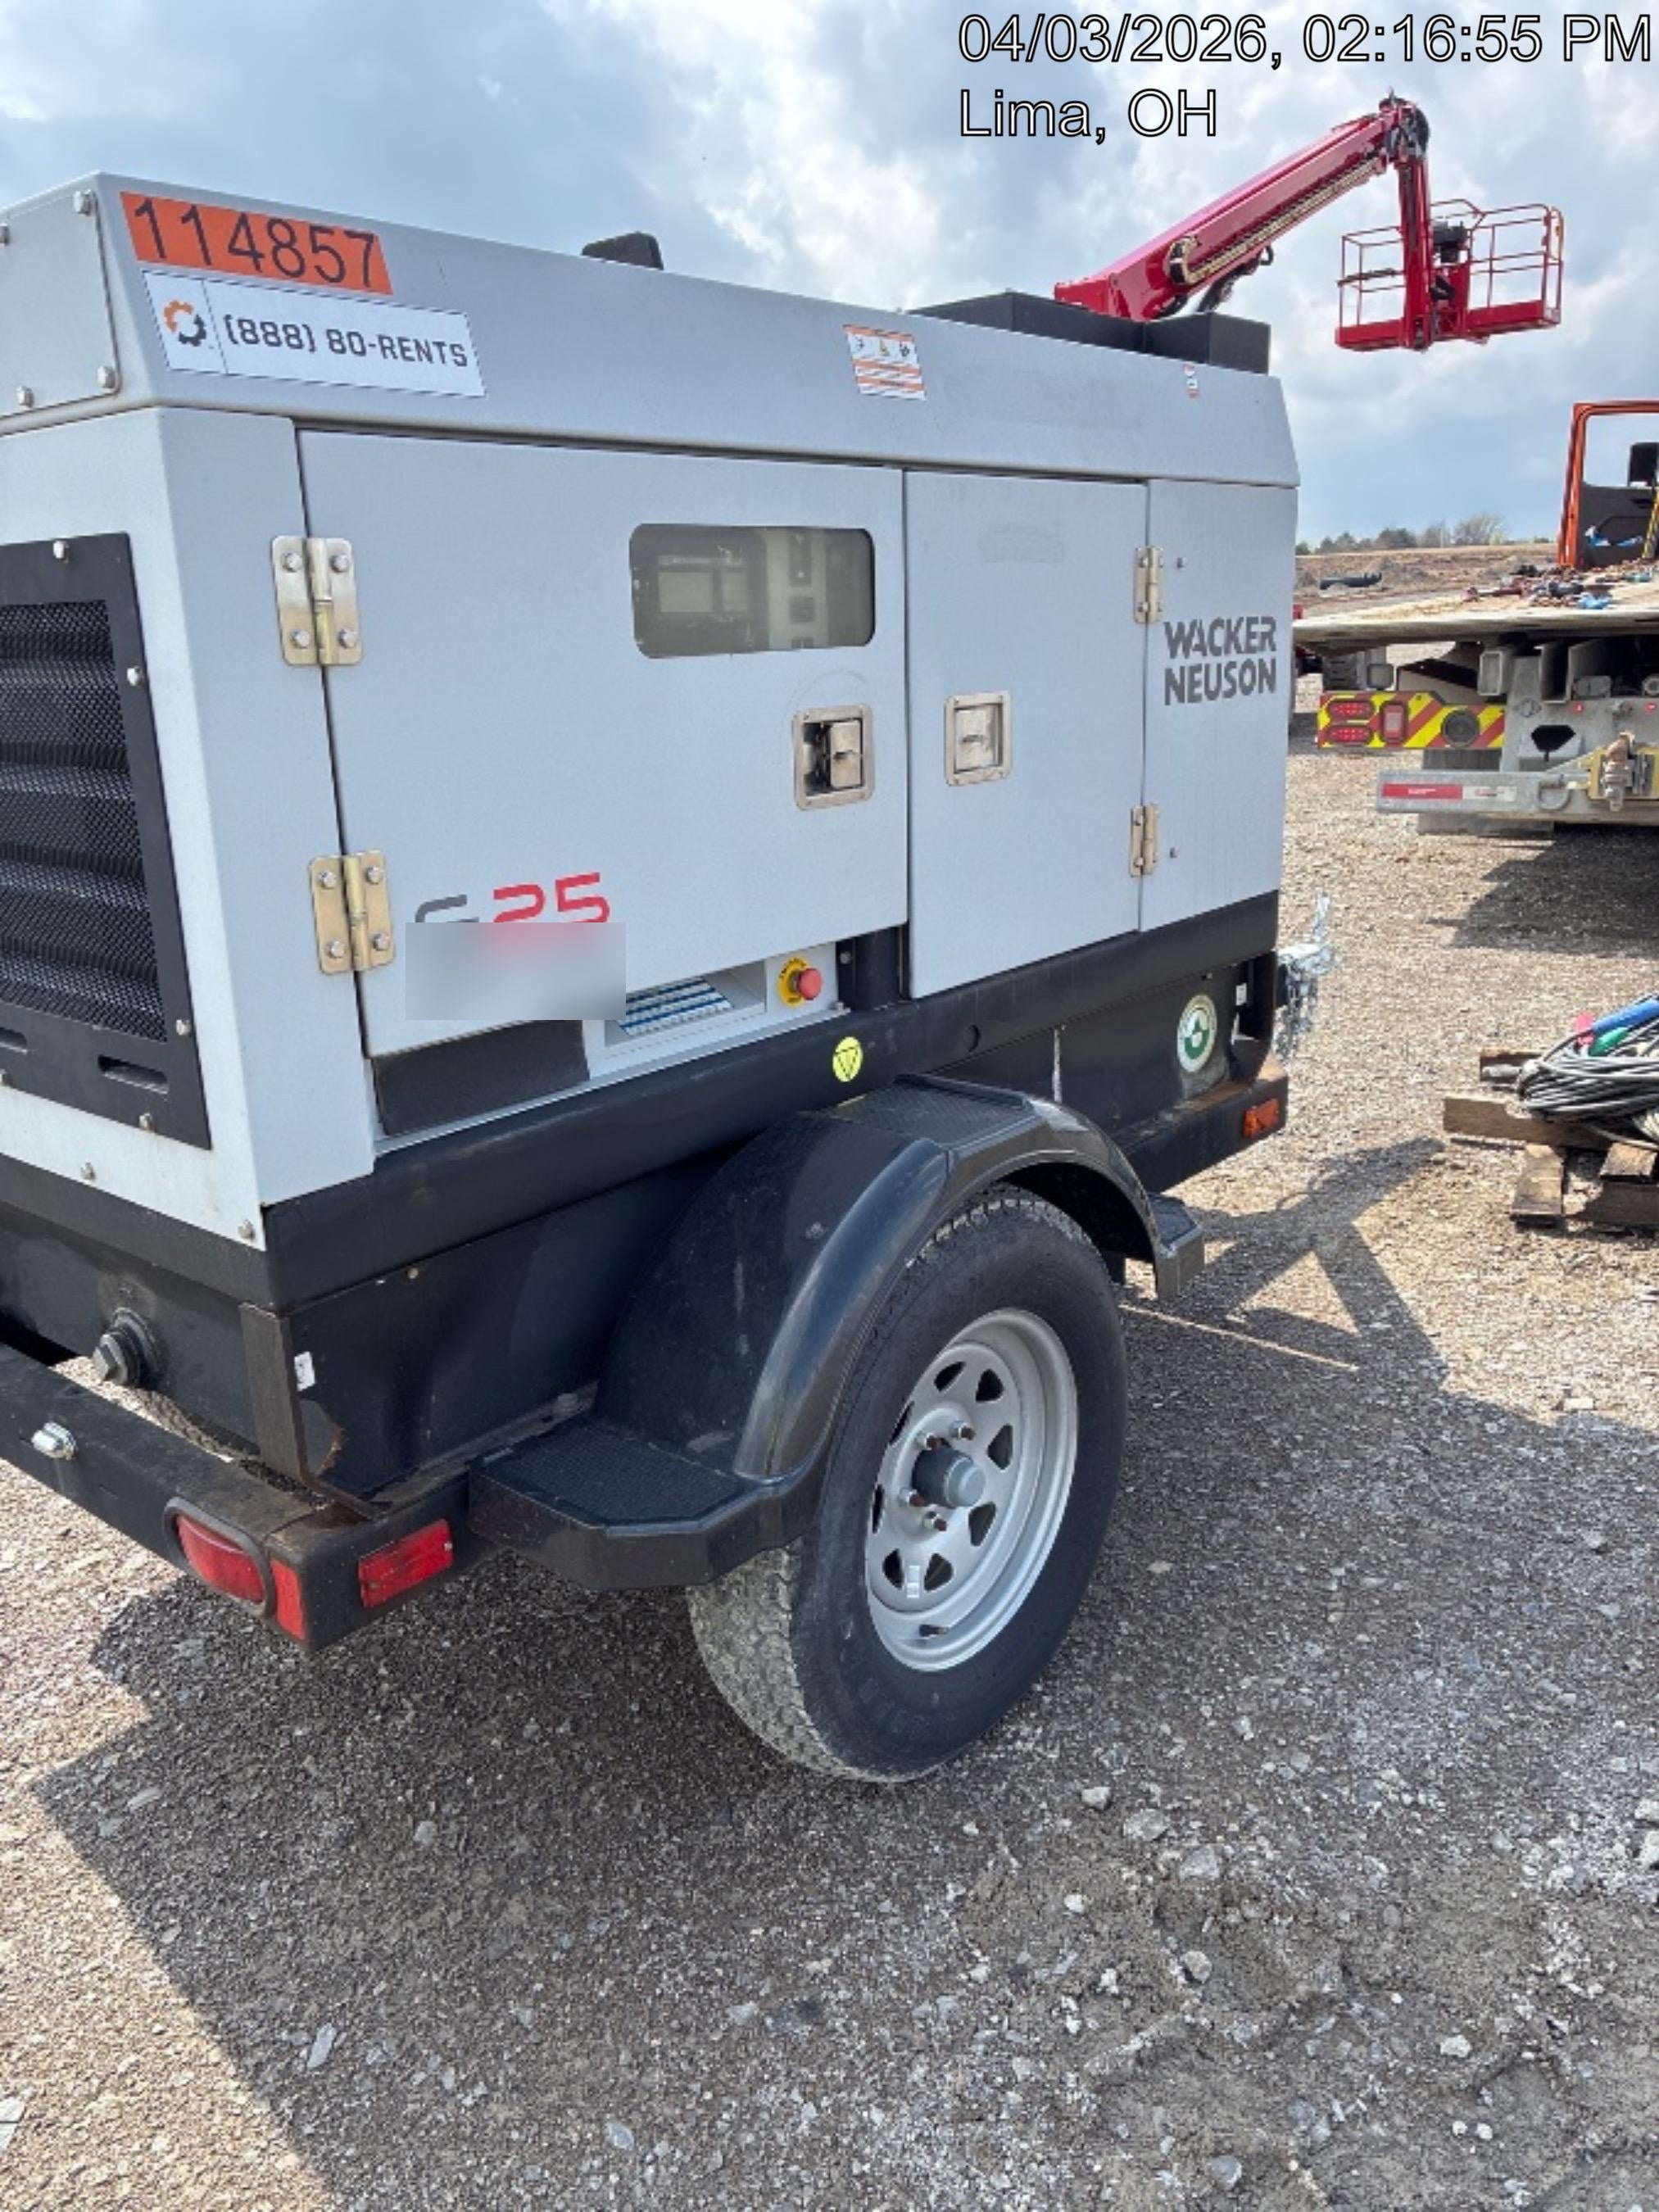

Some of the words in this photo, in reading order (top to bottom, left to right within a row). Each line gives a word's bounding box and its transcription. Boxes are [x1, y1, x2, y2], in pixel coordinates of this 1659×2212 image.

[134, 197, 376, 288] 114857
[224, 314, 317, 353] (888)
[327, 328, 469, 368] 80-RENTS
[1163, 616, 1276, 660] WACKER
[1164, 658, 1276, 706] NEUSON
